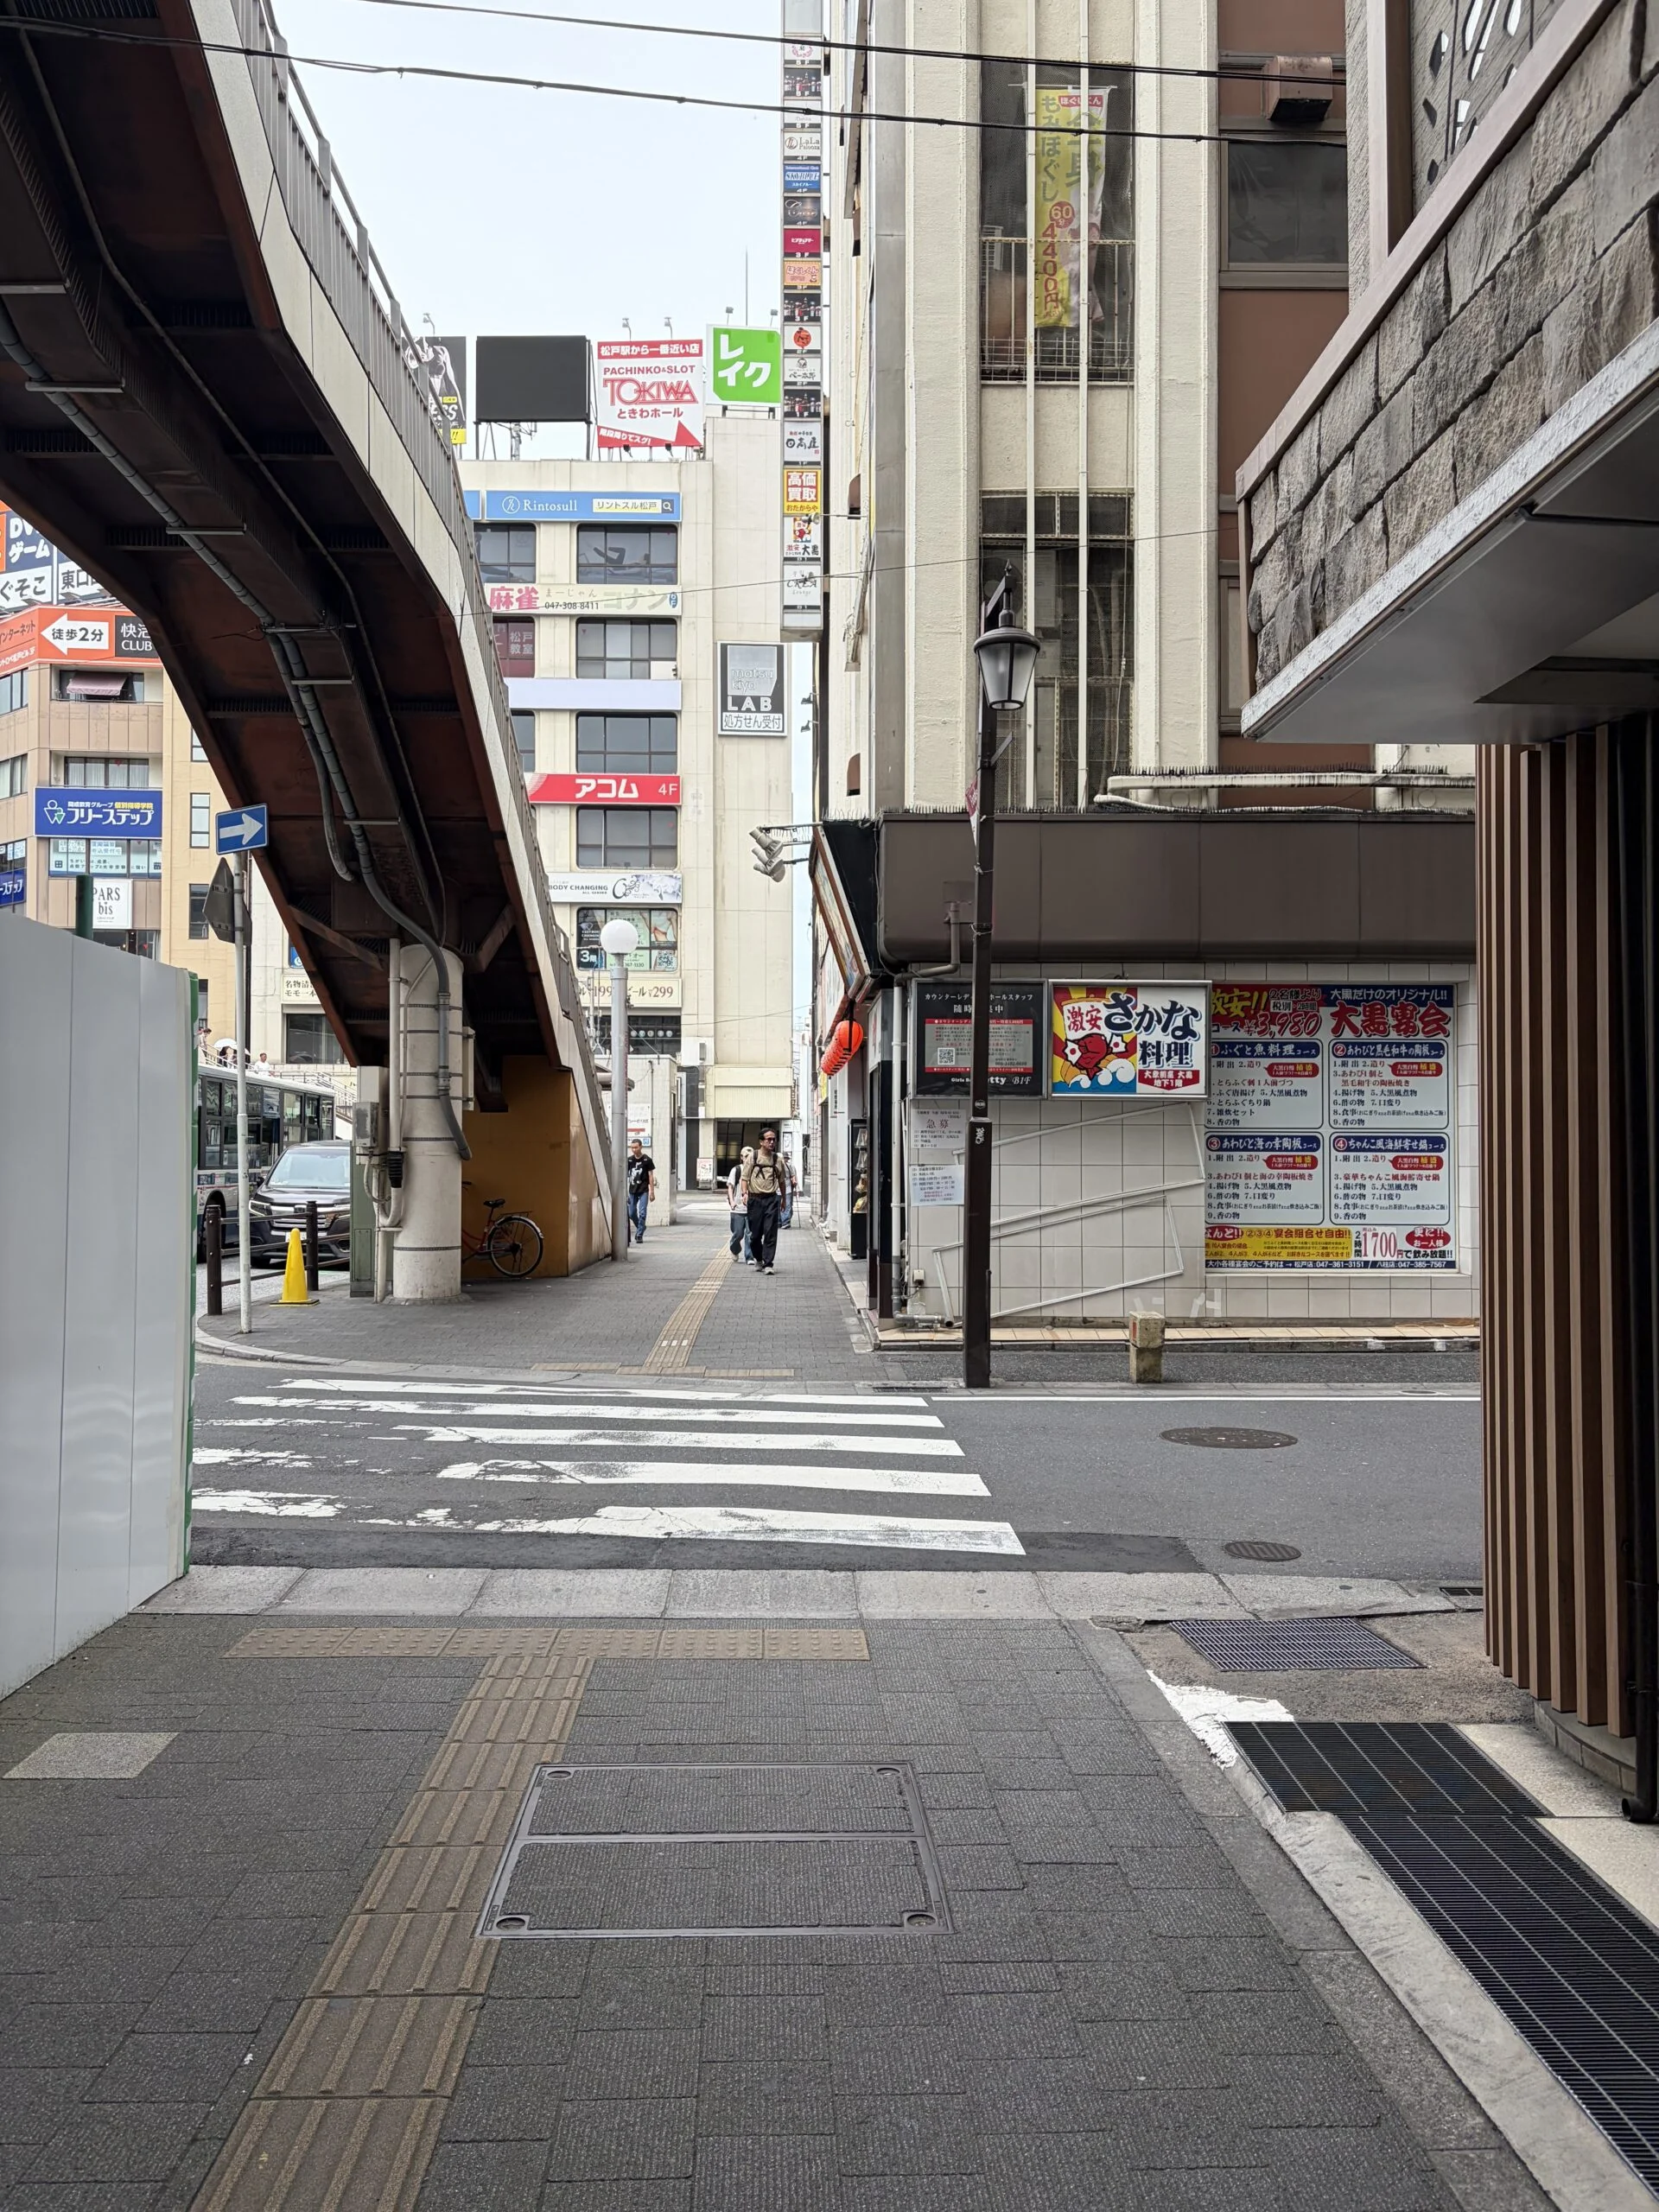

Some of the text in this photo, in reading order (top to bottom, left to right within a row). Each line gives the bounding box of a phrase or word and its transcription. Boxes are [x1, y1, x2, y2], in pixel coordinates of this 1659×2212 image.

[1040, 95, 1061, 202] もみほぐし
[1051, 206, 1072, 219] 60
[601, 343, 700, 356] 松戸駅から一番近い店
[603, 365, 696, 375] PACHINKO&SLOT
[603, 378, 699, 406] TOKIWA
[617, 407, 683, 419] ときわホール
[785, 436, 819, 449] 日高屋
[787, 472, 817, 486] 高価
[787, 487, 817, 502] 買取
[524, 499, 577, 512] Rintosull
[597, 501, 657, 511] リントスル松戸
[10, 517, 41, 539] DV
[9, 539, 50, 564] ゲーム
[802, 544, 819, 556] 大黒
[0, 575, 46, 601] ぐそこ
[545, 588, 597, 598] まーじゃん
[490, 586, 539, 610] 麻雀
[604, 588, 669, 611] コナン
[52, 626, 104, 642] 徒歩2分
[510, 632, 533, 643] 松戸
[121, 639, 152, 652] CLUB
[510, 644, 533, 655] 教室
[732, 667, 774, 678] matsu
[728, 696, 772, 711] LAB
[724, 714, 781, 728] 処方せん受付
[575, 779, 639, 798] アコム
[658, 783, 678, 796] 4F
[67, 808, 155, 825] フリーステップ
[99, 901, 113, 915] bis
[1331, 988, 1448, 1001] 大黒だけのオリジナル!!
[953, 1004, 1003, 1014] 随時中
[1067, 992, 1202, 1041] 激安 さかな
[1330, 1001, 1451, 1037] 大黒宴会
[1139, 1040, 1193, 1068] 料理
[1211, 1089, 1255, 1097] .ふぐ唐揚げ
[1354, 1231, 1363, 1258] 2時間
[1363, 1232, 1397, 1257] 1700
